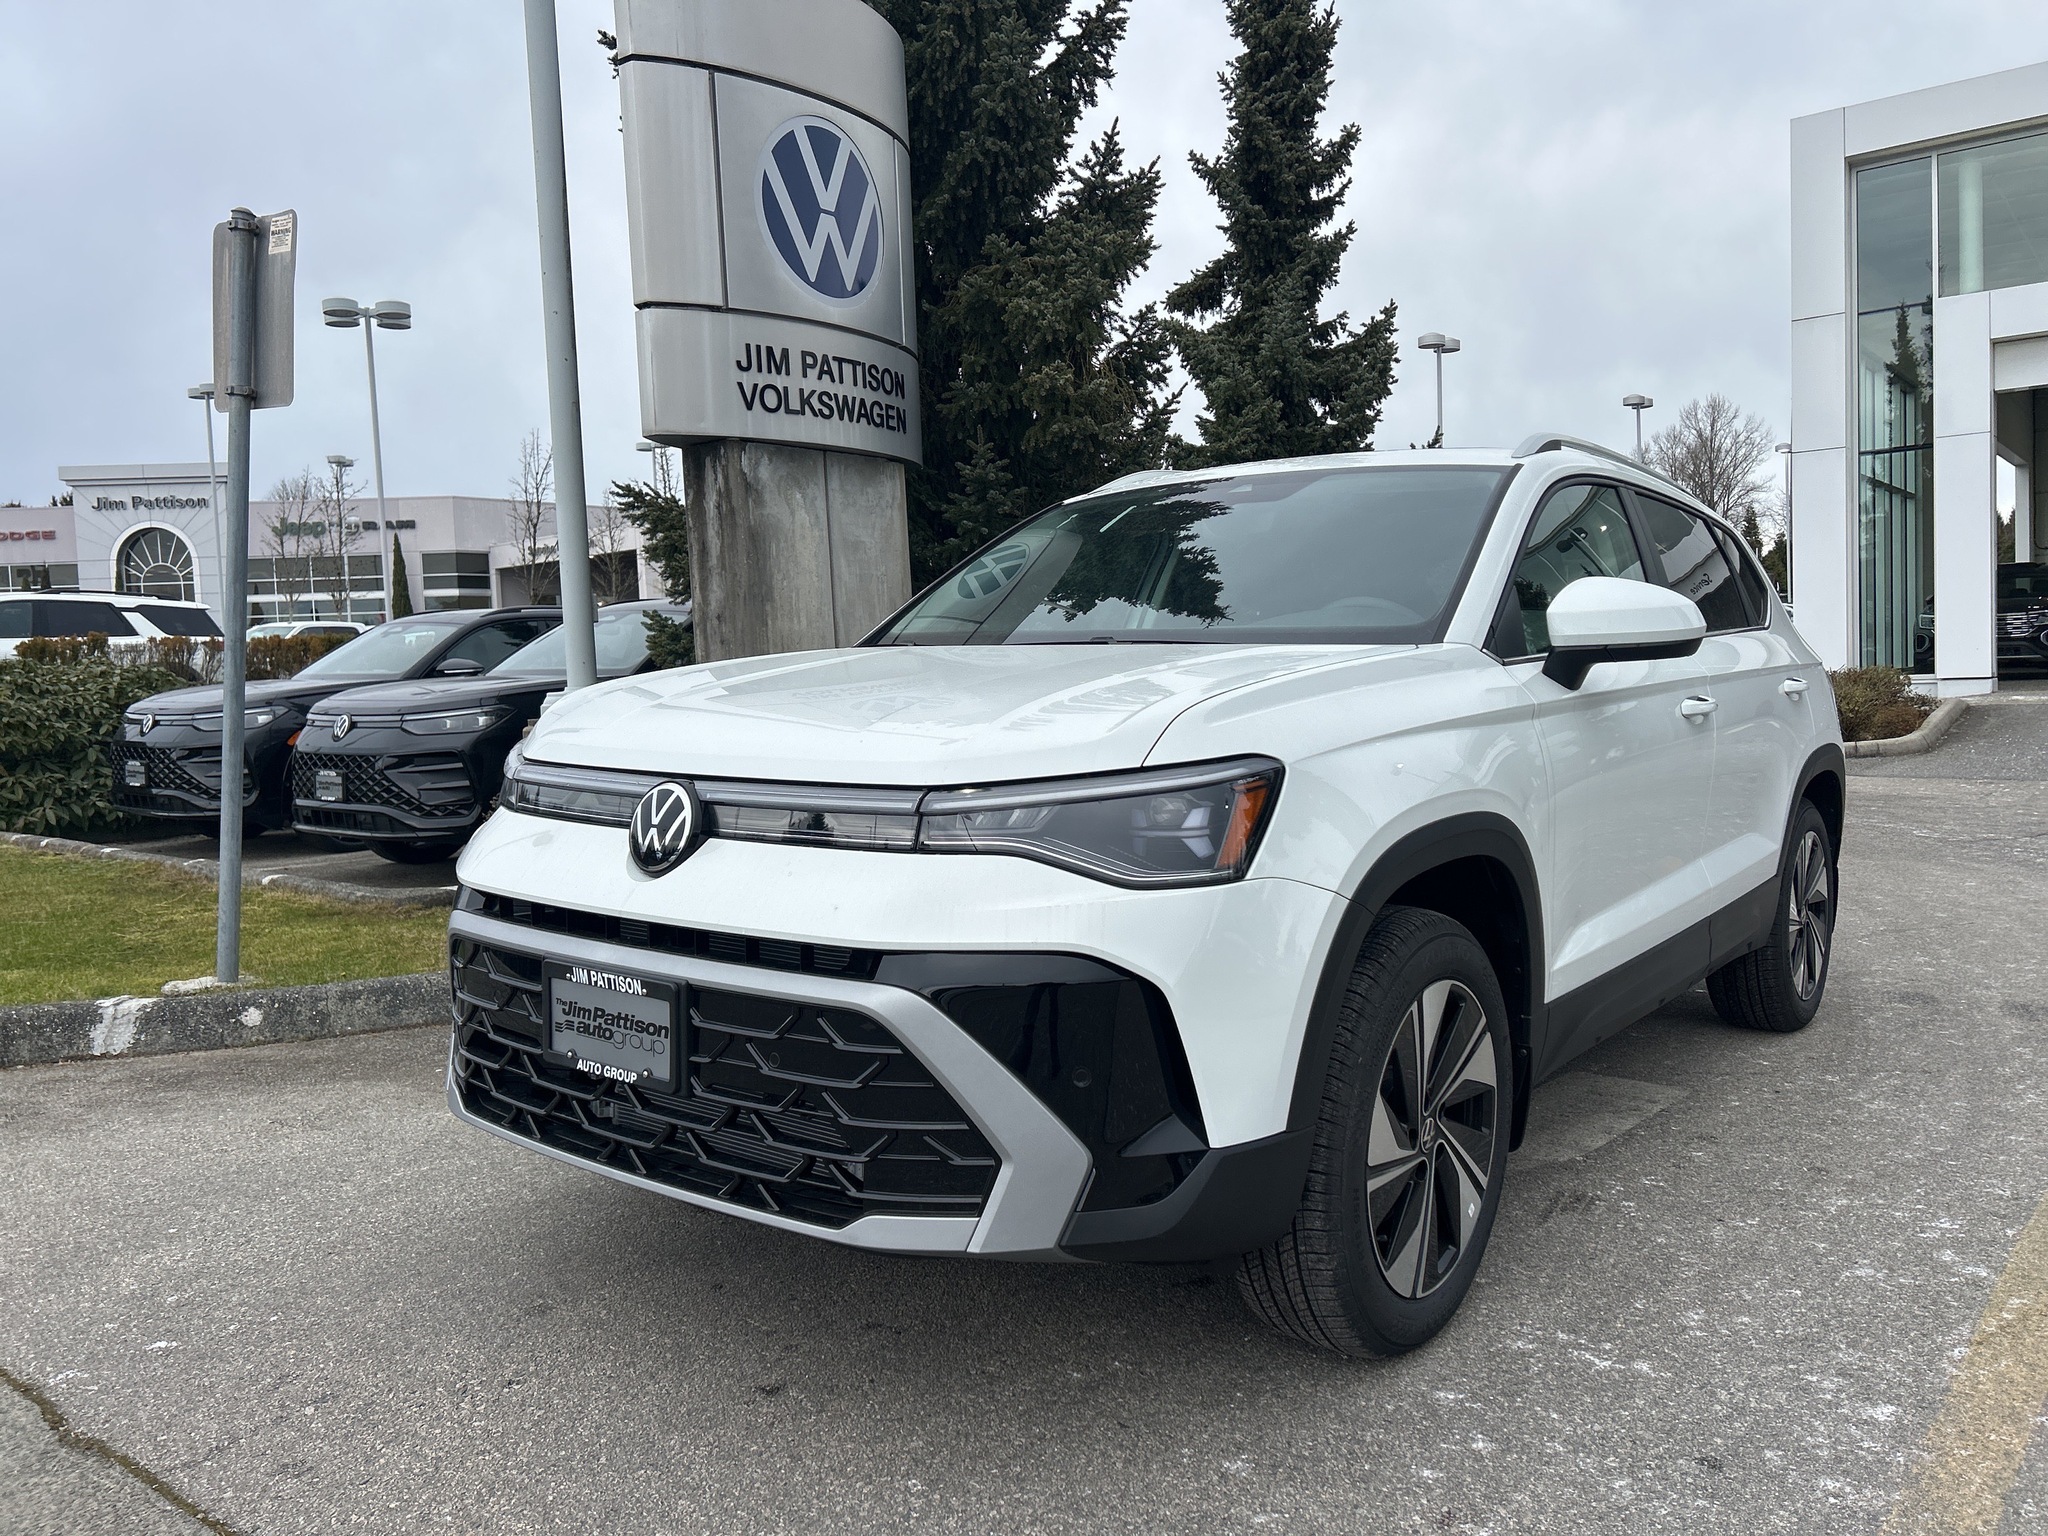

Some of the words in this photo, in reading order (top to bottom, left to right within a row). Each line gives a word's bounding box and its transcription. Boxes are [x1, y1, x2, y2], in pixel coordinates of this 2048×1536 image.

[736, 342, 790, 376] JIM
[801, 350, 905, 400] PATTISON
[737, 381, 907, 434] VOLKSWAGEN
[92, 496, 127, 511] Jim
[131, 495, 209, 511] Pattison
[271, 517, 326, 538] Jeep
[571, 966, 588, 985] JIM
[590, 970, 642, 996] PATTISON
[555, 998, 568, 1007] The
[576, 1058, 602, 1076] AUTO
[604, 1066, 638, 1085] GROUP
